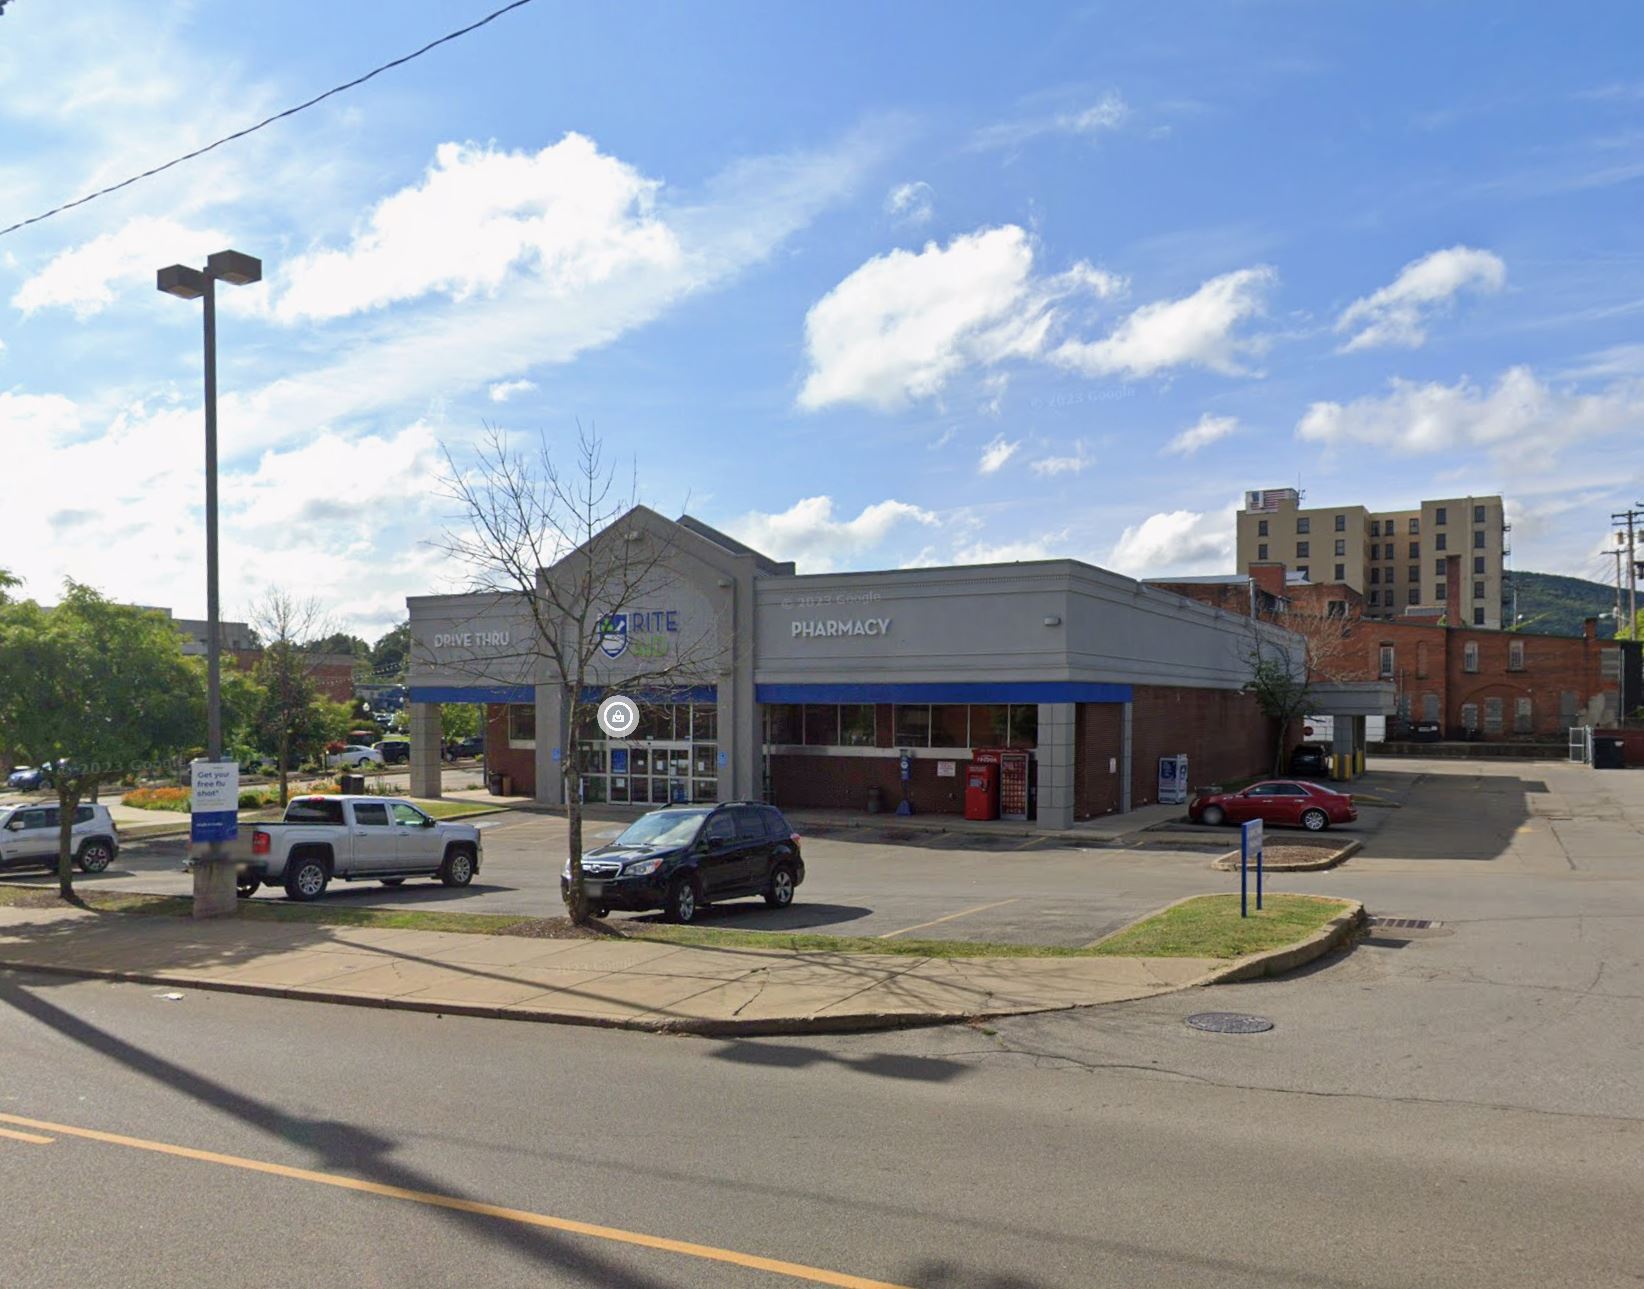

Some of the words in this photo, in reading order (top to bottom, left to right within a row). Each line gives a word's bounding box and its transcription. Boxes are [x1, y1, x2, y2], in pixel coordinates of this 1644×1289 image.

[632, 609, 679, 632] RITE
[791, 618, 891, 637] PHARMACY
[433, 632, 473, 648] DRIVE
[474, 631, 509, 647] THRU
